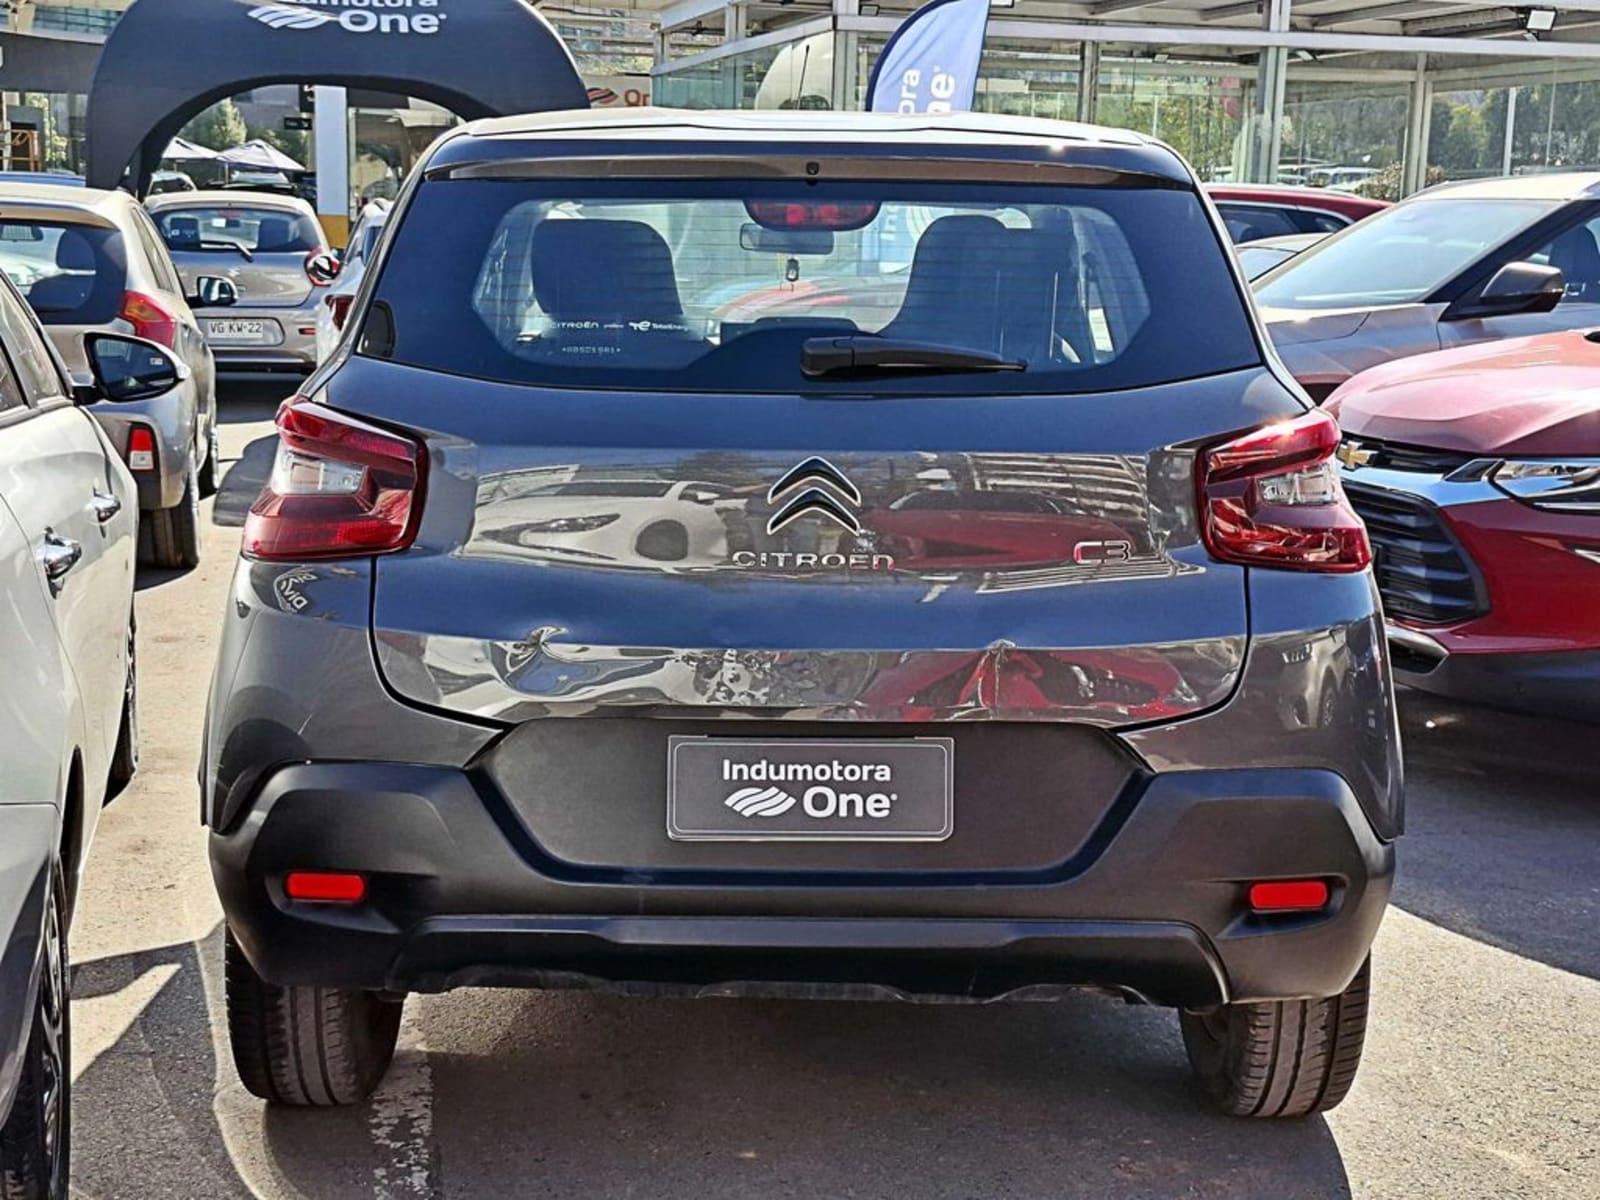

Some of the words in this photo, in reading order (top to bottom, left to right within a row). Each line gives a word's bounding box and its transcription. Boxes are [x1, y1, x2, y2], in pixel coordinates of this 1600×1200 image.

[339, 9, 440, 34] One
[210, 322, 225, 334] VG
[1073, 540, 1132, 566] C3
[722, 758, 892, 782] Indumotora
[802, 785, 892, 819] One
